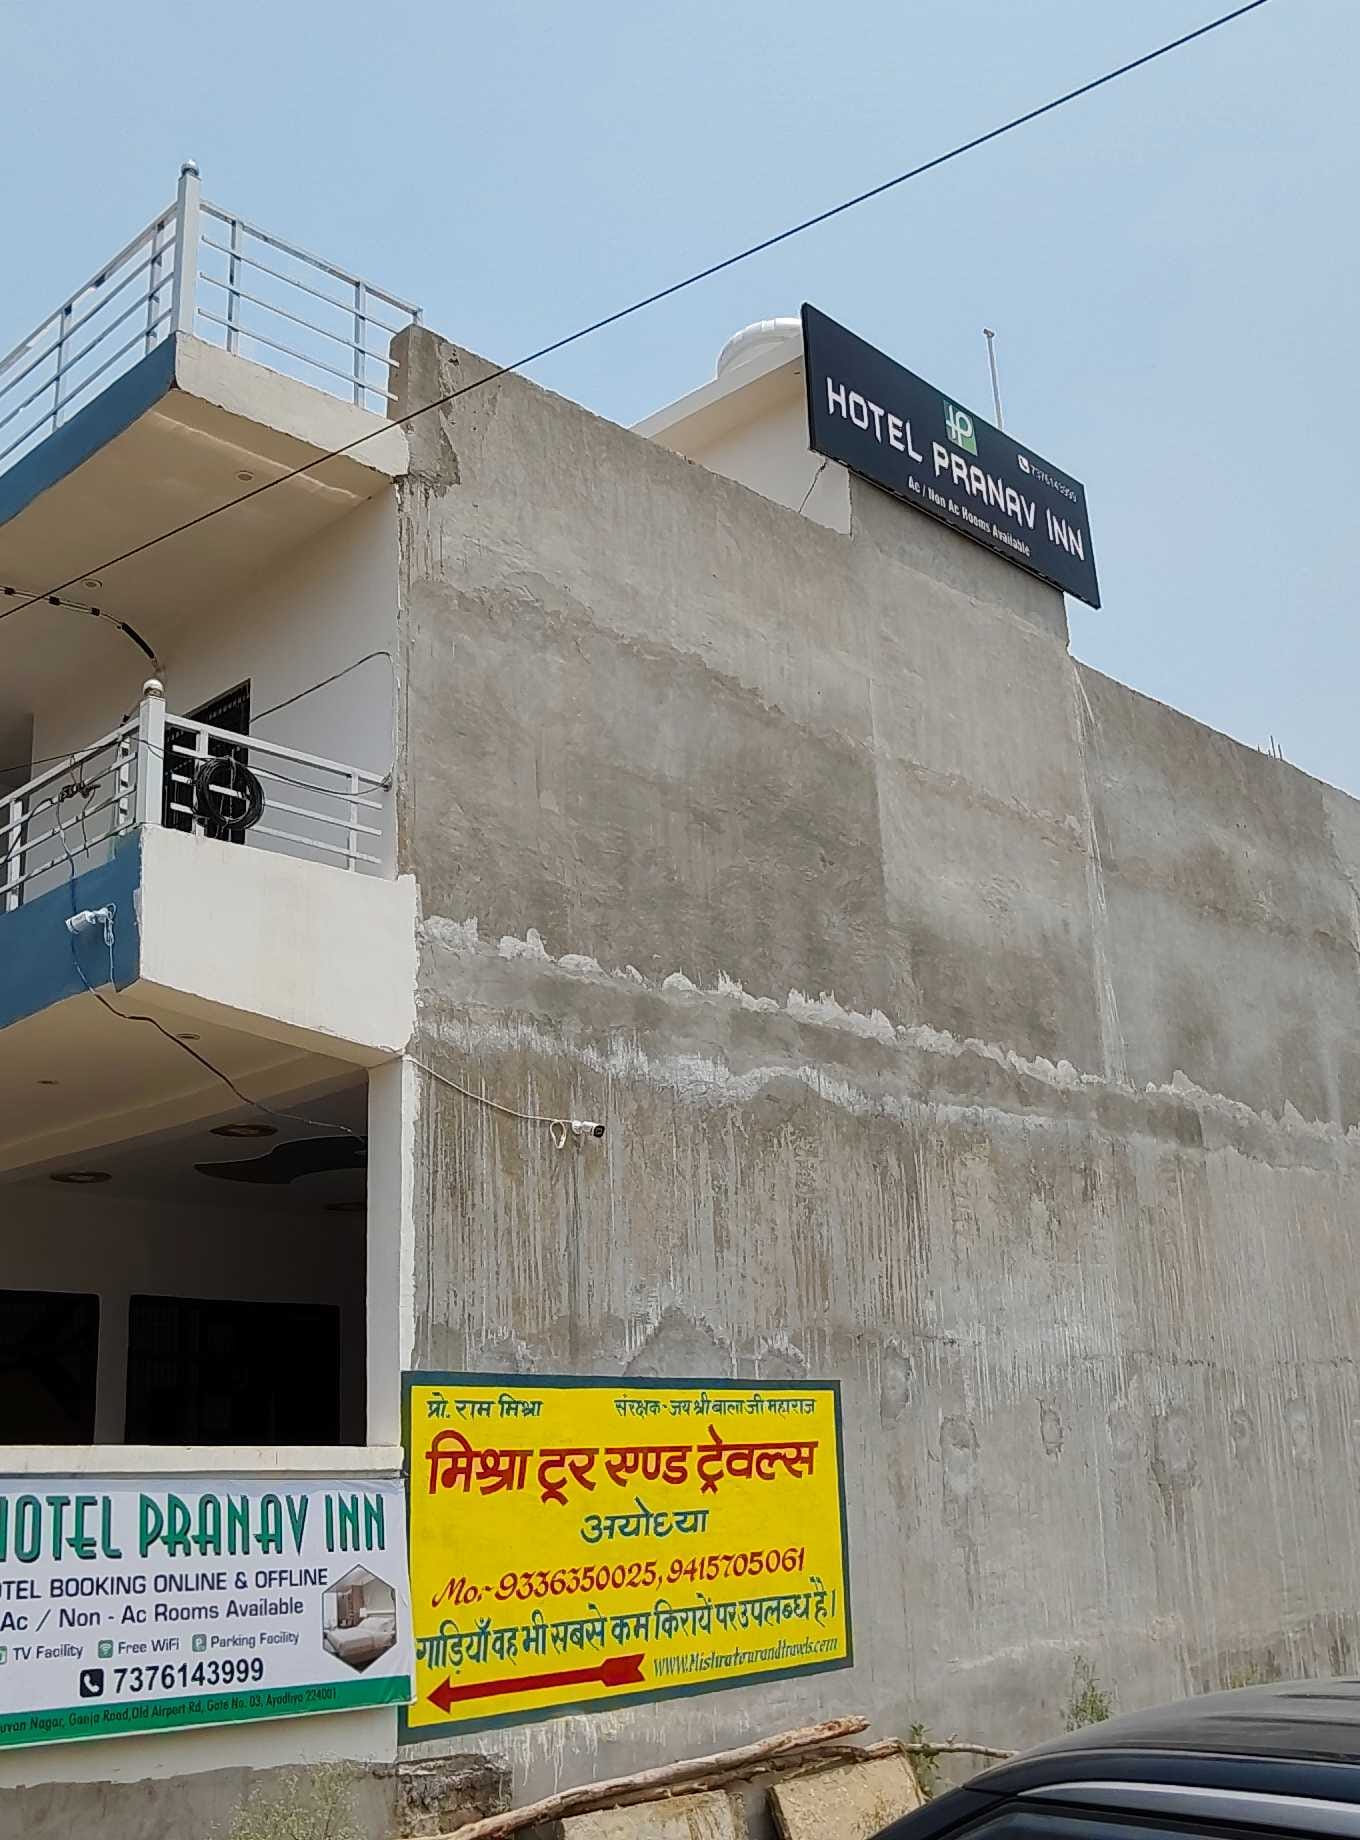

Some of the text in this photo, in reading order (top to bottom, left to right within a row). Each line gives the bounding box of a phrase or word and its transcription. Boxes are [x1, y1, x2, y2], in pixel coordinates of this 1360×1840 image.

[826, 376, 1085, 561] HOTEL PRANAV INN
[908, 476, 921, 493] Ac
[928, 487, 946, 508] Non
[948, 499, 960, 516] Ac
[962, 506, 991, 533] Rooms
[993, 524, 1030, 557] Available
[455, 1400, 495, 1420] राम
[498, 1393, 543, 1418] मिश्रा
[767, 1399, 816, 1420] महाराज
[425, 1430, 534, 1495] मिश्रा
[696, 1424, 819, 1494] ट्रेवल्स
[140, 1493, 309, 1557] PRANAV
[325, 1493, 386, 1553] INN
[580, 1496, 710, 1543] अयोध्या
[667, 1547, 805, 1583] 9415705061
[50, 1575, 146, 1598] BOOKING
[154, 1571, 227, 1593] ONLINE
[235, 1574, 248, 1590] &
[255, 1568, 328, 1588] OFFLINE
[0, 1611, 28, 1632] Ac
[35, 1609, 51, 1632] /
[59, 1607, 100, 1628] Non
[121, 1605, 147, 1625] Ac
[154, 1602, 219, 1622] Rooms
[226, 1597, 304, 1618] Available
[522, 1609, 550, 1656] भी
[551, 1602, 607, 1654] सबसे
[610, 1611, 651, 1645] कम
[13, 1644, 83, 1660] TV Facility
[118, 1638, 179, 1654] Free WiFi
[211, 1631, 300, 1648] Parking Facility
[113, 1657, 264, 1693] 7376143999
[151, 1703, 186, 1718] Airport
[305, 1688, 336, 1700] 224001
